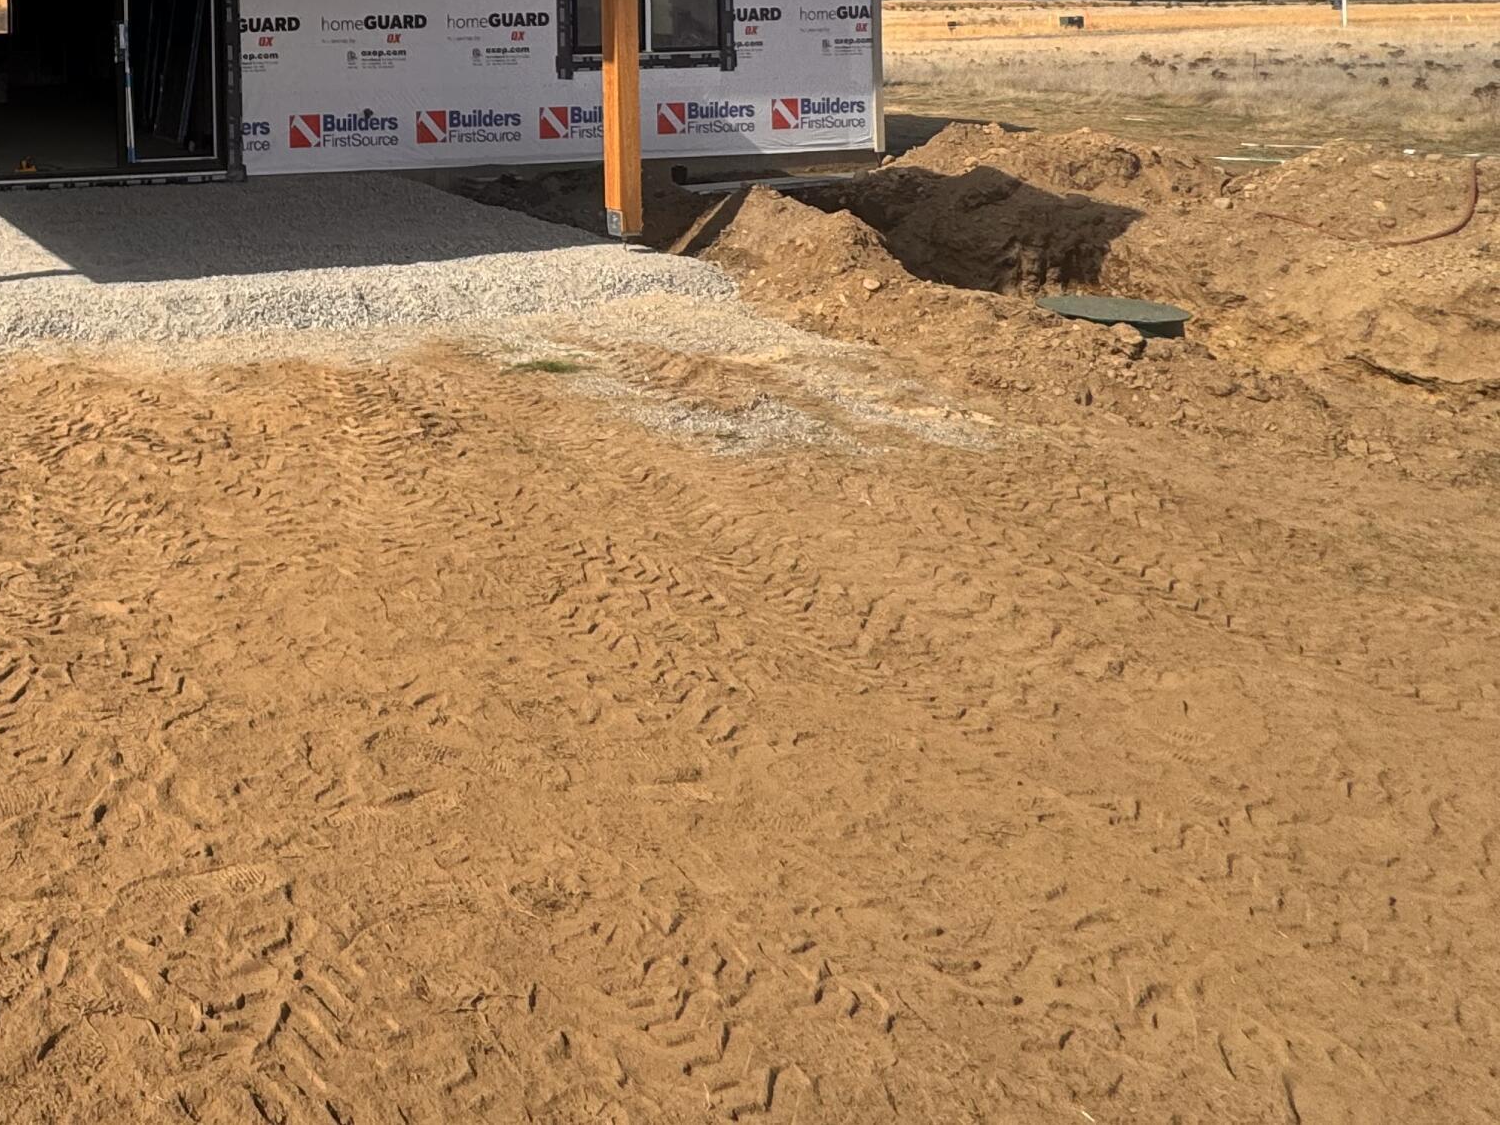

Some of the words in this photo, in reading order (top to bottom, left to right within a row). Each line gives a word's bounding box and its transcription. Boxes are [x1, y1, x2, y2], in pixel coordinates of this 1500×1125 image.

[446, 12, 550, 30] homeGUARD
[799, 5, 872, 21] homeGUA
[239, 17, 301, 33] GUARD
[321, 15, 427, 32] homeGUARD
[258, 36, 274, 47] OX
[387, 34, 401, 44] OX
[511, 31, 525, 41] OX
[571, 106, 603, 123] Buil
[687, 101, 755, 119] Builders
[800, 98, 865, 115] Builders
[322, 114, 398, 132] Builders
[448, 109, 521, 128] Builders
[800, 115, 866, 130] FirstSource
[571, 125, 604, 139] FirstS
[687, 120, 755, 134] FirstSource
[322, 133, 399, 147] FirstSource
[448, 128, 521, 143] FirstSource
